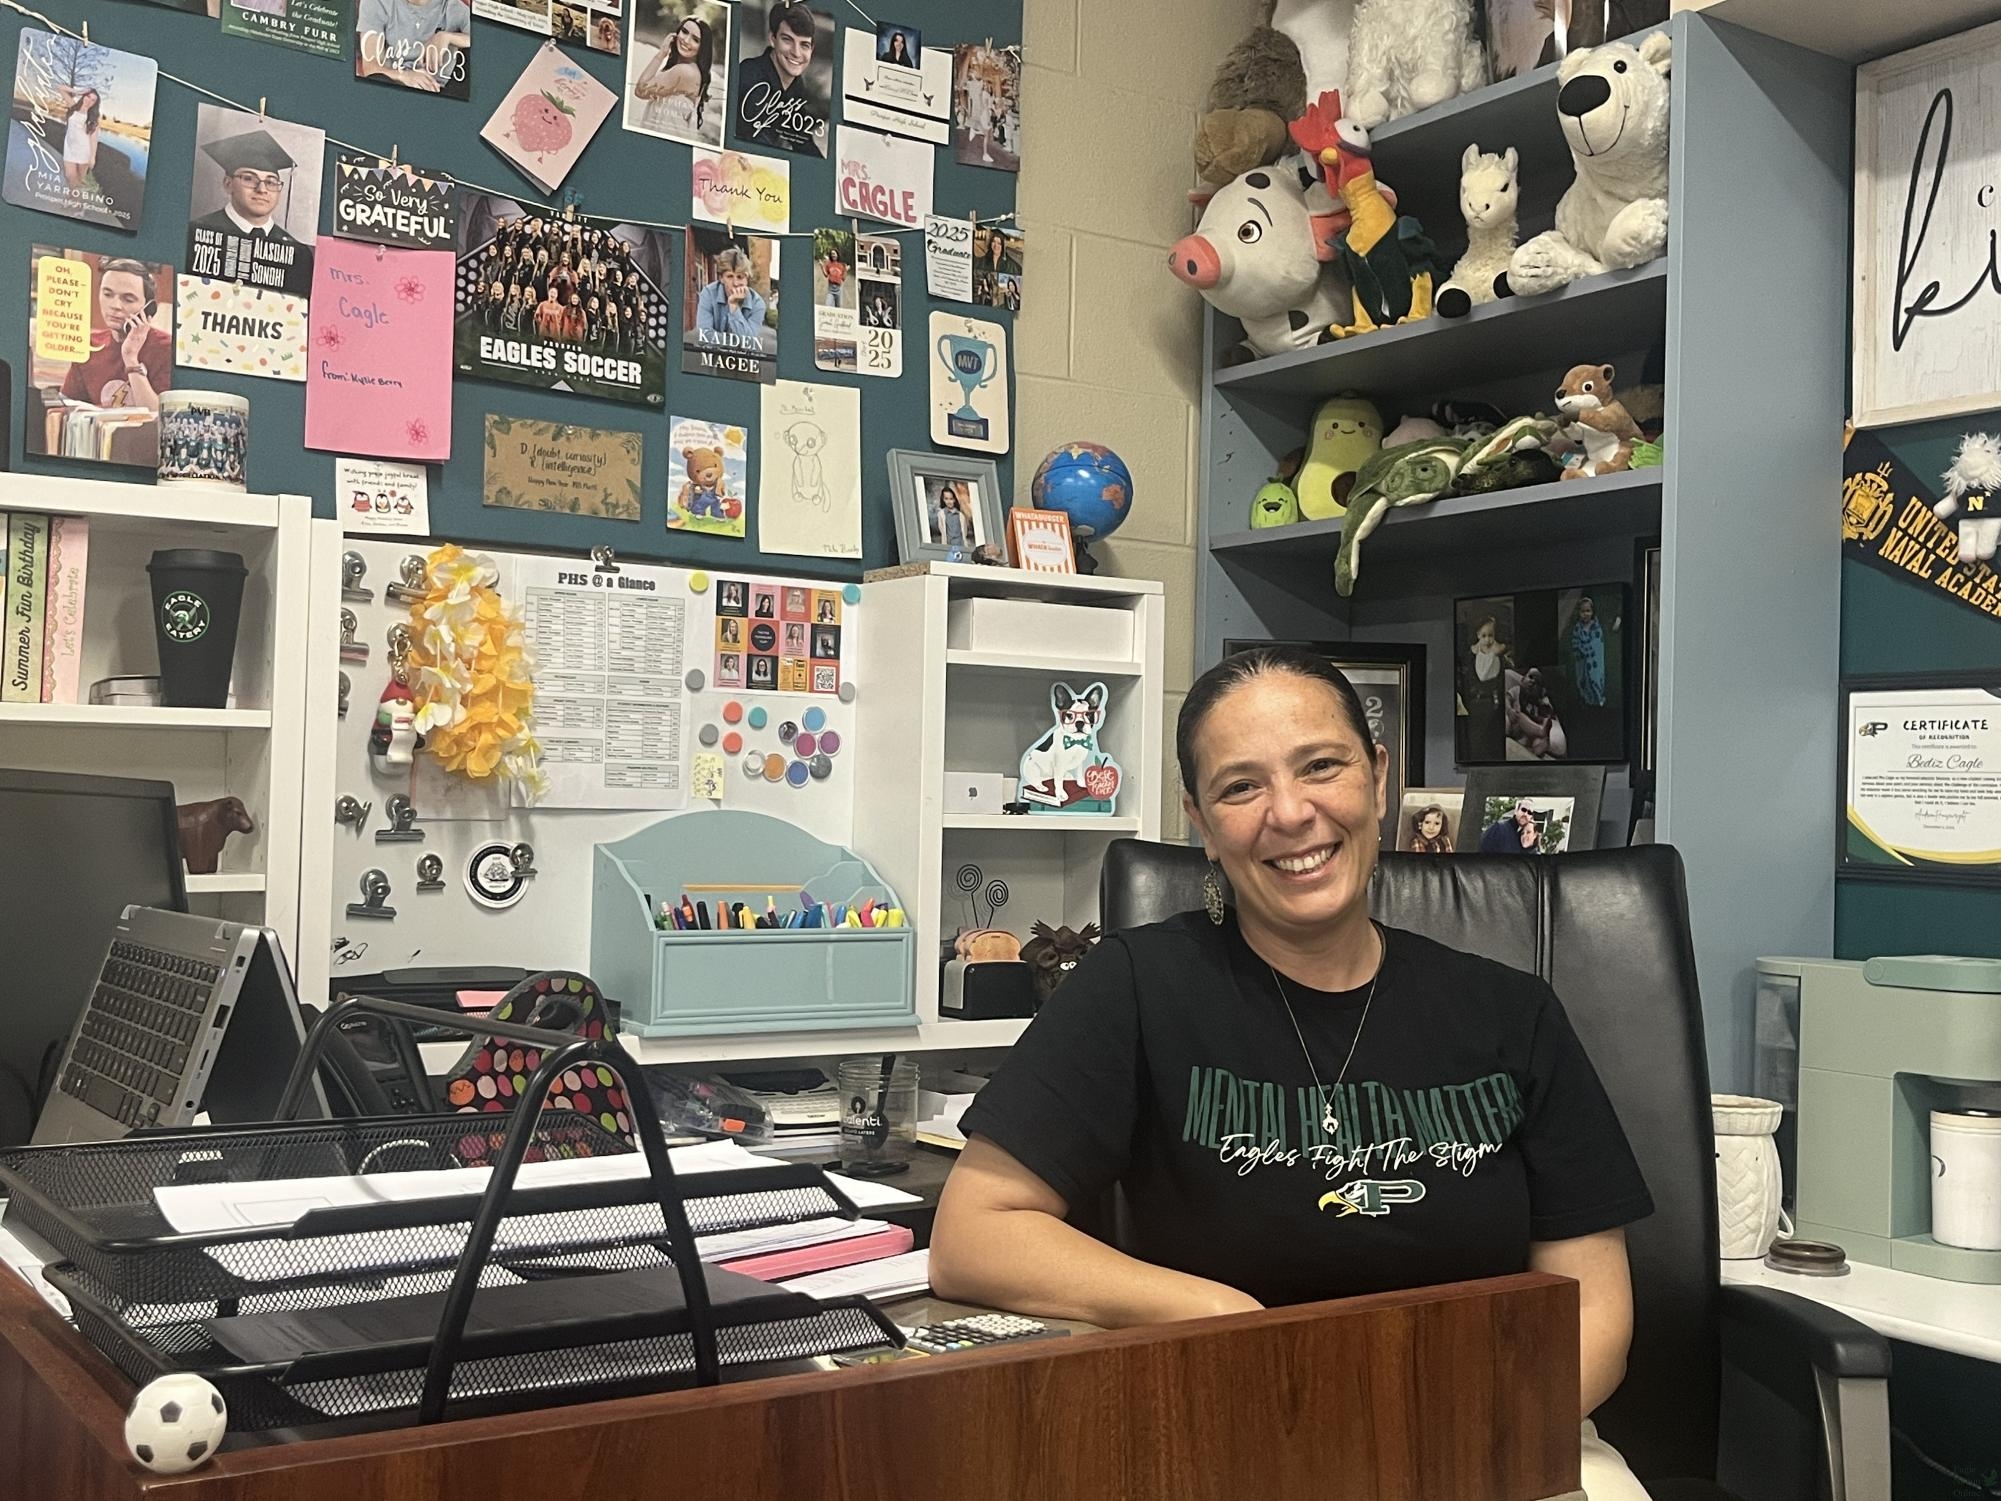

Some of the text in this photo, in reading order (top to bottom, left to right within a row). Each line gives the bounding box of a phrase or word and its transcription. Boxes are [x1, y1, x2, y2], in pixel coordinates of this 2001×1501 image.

[242, 11, 296, 32] CAMBRY
[304, 26, 337, 42] FURR
[361, 30, 411, 67] Class
[412, 41, 466, 82] 2023
[741, 82, 808, 122] Class
[781, 110, 825, 137] 2023
[38, 171, 61, 183] MIA
[841, 158, 871, 180] MRS.
[37, 182, 114, 206] YARROBINO
[364, 185, 428, 215] So Very
[699, 177, 783, 204] Thank You
[842, 176, 917, 223] CAGLE
[339, 199, 451, 239] GRATEFUL
[195, 228, 214, 245] CLASS
[926, 222, 970, 242] 2025
[192, 244, 223, 276] 2025
[253, 237, 295, 266] ALASDAIR
[251, 261, 286, 288] SONDHI
[48, 287, 80, 298] DON'T
[54, 299, 73, 309] CRY
[42, 309, 84, 321] BECAUSE
[338, 296, 390, 329] Cagle
[41, 331, 83, 343] GETTING
[45, 320, 81, 332] YOU'RE
[201, 310, 284, 340] THANKS
[699, 328, 764, 351] KAIDEN
[868, 329, 894, 349] 20
[480, 335, 557, 370] EAGLES
[563, 351, 642, 385] SOCCER
[701, 352, 761, 374] MAGEE
[868, 349, 893, 370] 25
[1967, 496, 1985, 512] N
[1897, 496, 1960, 566] UNITED
[1878, 527, 1937, 580] NAVAL
[557, 572, 656, 591] PHS @ a Glance
[12, 522, 41, 691] Summer Fun Birthday
[61, 567, 80, 657] Let's Celebrate
[165, 594, 202, 611] EAGLE
[165, 619, 206, 639] EATERY
[1903, 719, 1989, 731] CERTIFICATE
[1946, 754, 1983, 772] Cagle
[1182, 1065, 1288, 1151] MENTAL
[1219, 1133, 1504, 1180] Eagles Fight The Stigm
